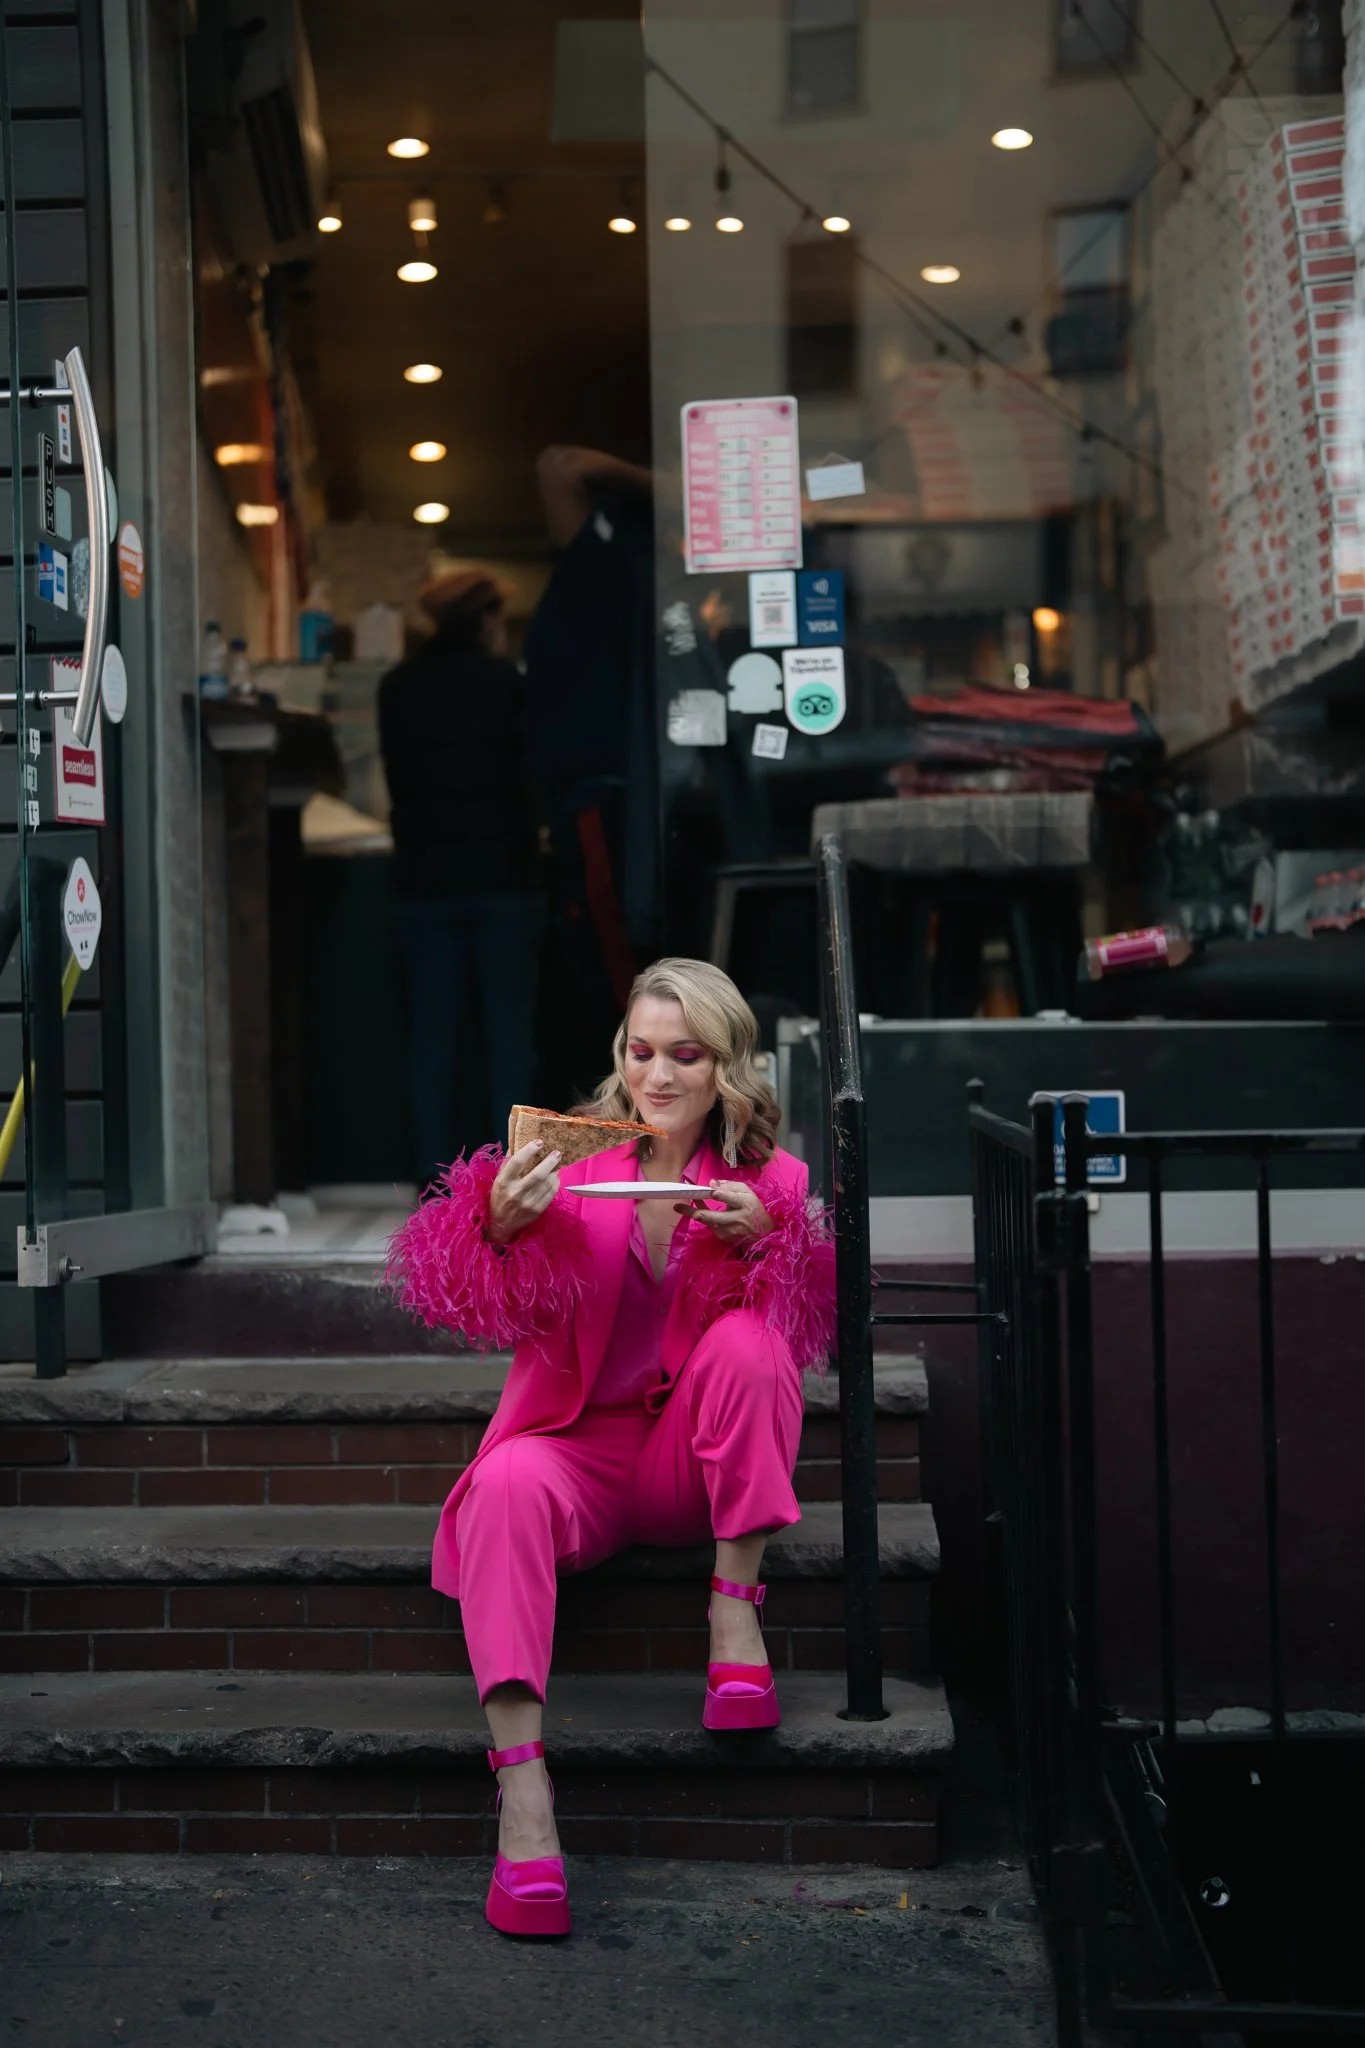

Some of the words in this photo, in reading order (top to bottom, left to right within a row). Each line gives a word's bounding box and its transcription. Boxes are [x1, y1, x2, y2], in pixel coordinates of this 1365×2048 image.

[46, 443, 54, 530] PUSH
[806, 619, 839, 633] VISA
[65, 759, 95, 777] seamless
[68, 908, 97, 926] ChowNow
